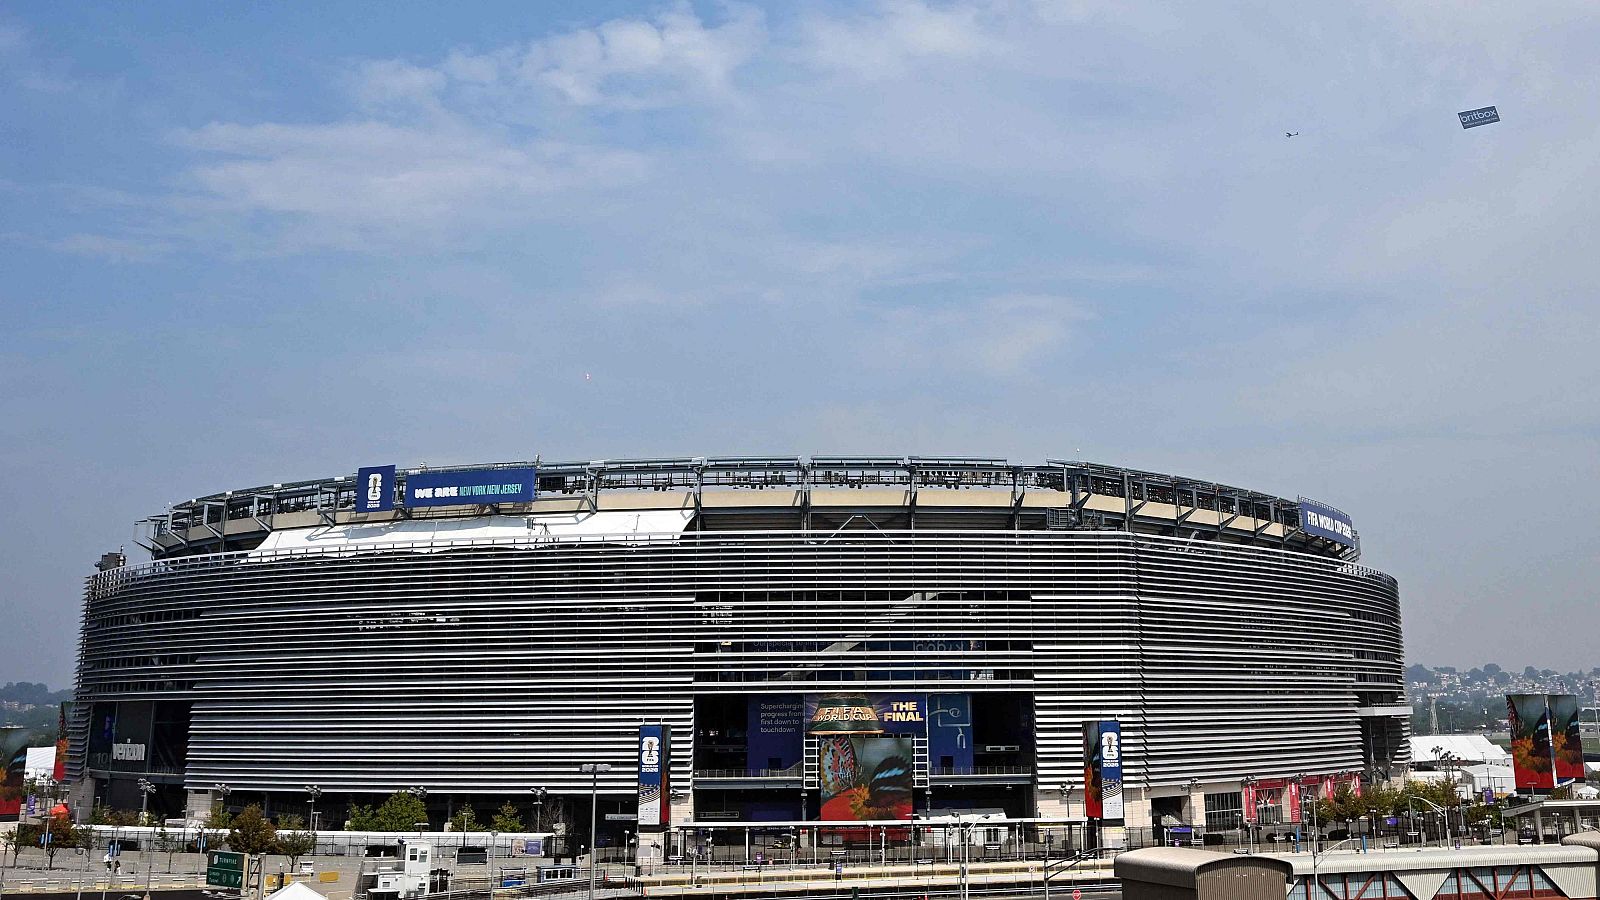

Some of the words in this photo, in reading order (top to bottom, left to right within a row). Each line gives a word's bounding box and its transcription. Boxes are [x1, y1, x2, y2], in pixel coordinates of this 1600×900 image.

[1460, 110, 1497, 122] britbox
[415, 487, 433, 499] WE
[434, 486, 459, 497] ARE
[459, 486, 471, 497] NEW
[471, 485, 486, 496] YORK
[486, 485, 500, 496] NEW
[1307, 511, 1319, 527] FIFA
[1318, 514, 1334, 531] WORLD
[1334, 520, 1343, 534] CUP
[1342, 523, 1352, 539] 2026
[760, 703, 804, 711] Superchargin
[891, 701, 917, 711] THE
[817, 713, 851, 721] WORLD
[852, 713, 872, 721] CUP
[883, 712, 924, 722] FINAL
[113, 738, 146, 760] verizon
